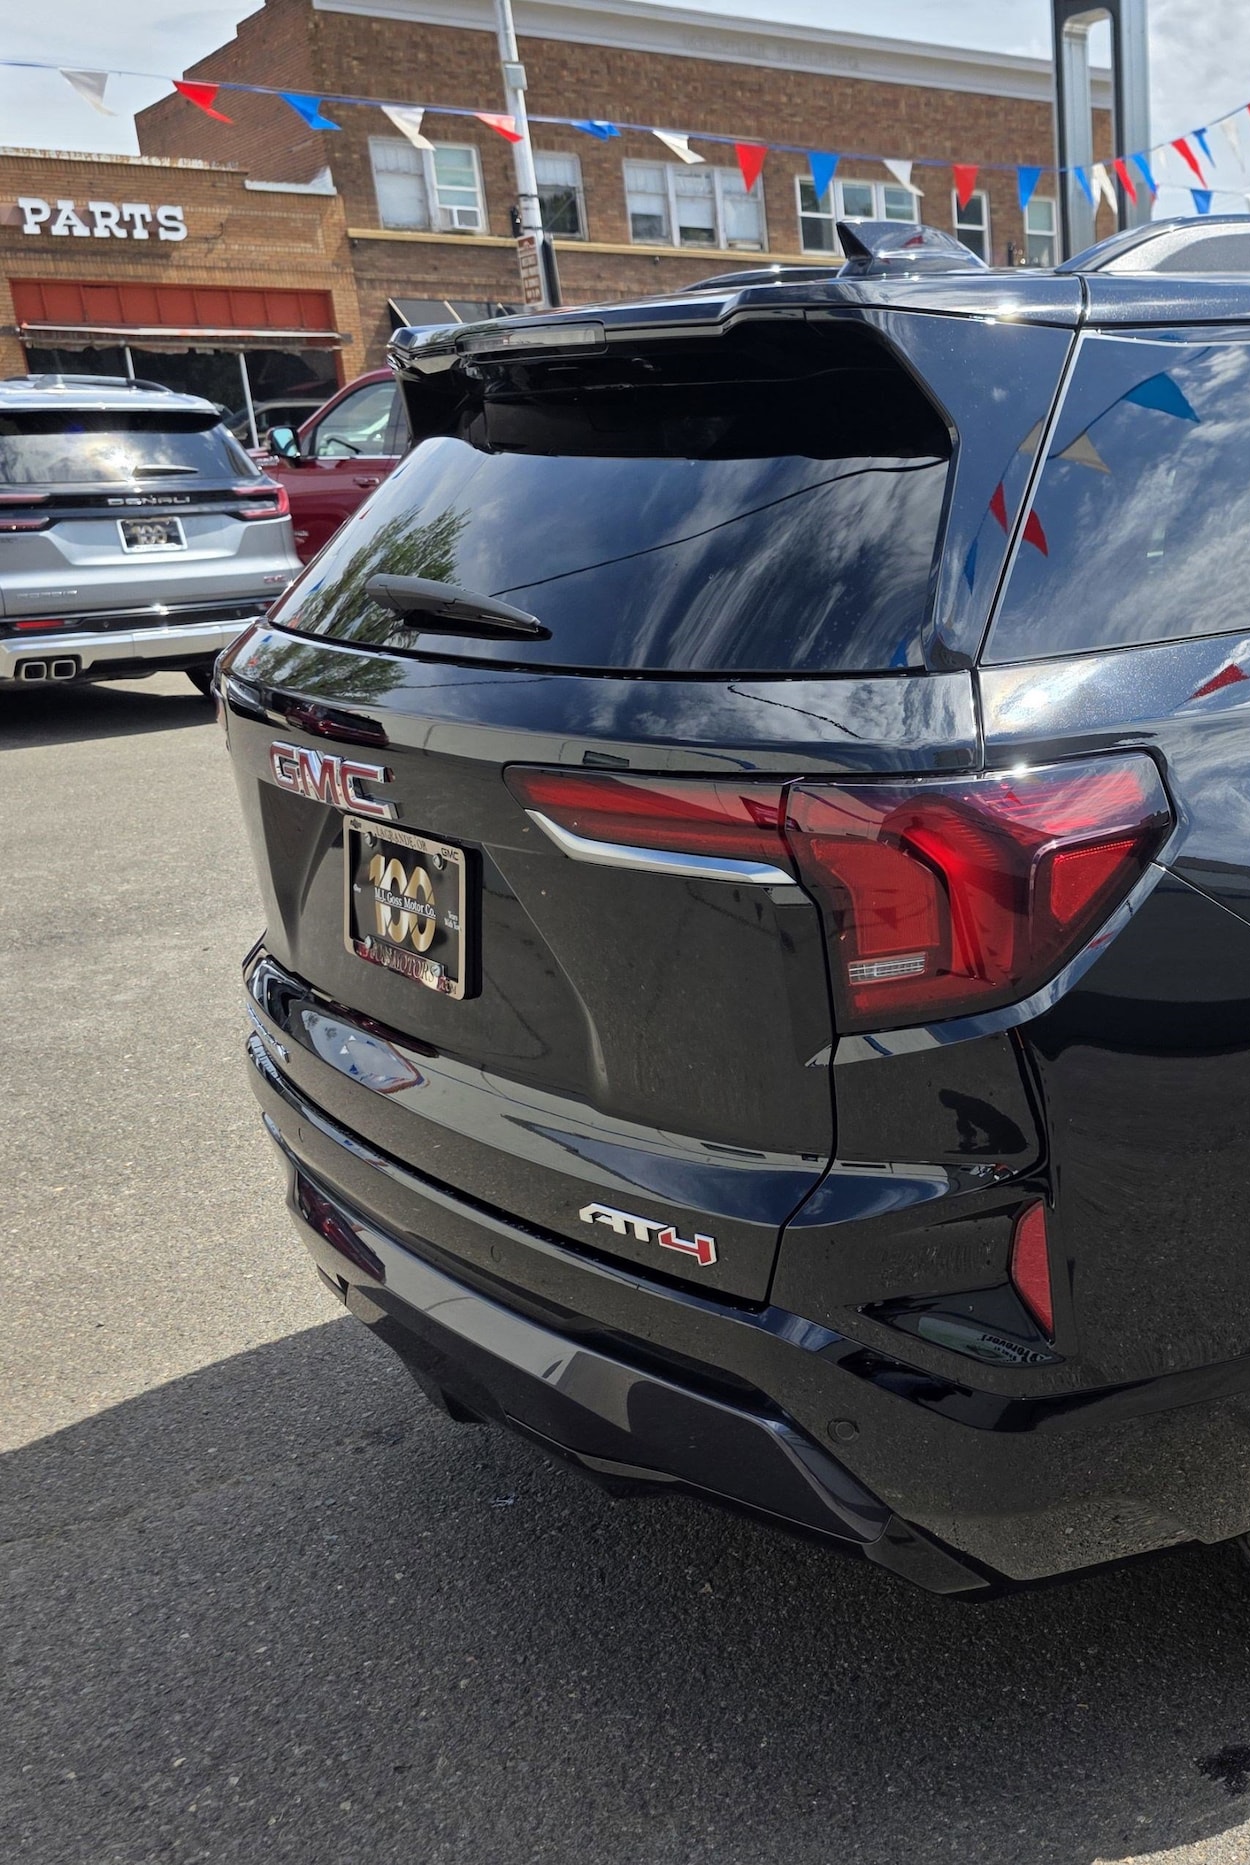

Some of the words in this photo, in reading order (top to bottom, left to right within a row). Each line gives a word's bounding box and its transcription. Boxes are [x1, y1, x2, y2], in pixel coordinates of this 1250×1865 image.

[18, 197, 188, 242] PARTS
[107, 495, 191, 506] DENALI
[269, 740, 399, 820] GMC
[441, 847, 459, 861] GMC
[387, 892, 402, 907] Goss
[404, 896, 424, 912] Motor
[425, 904, 437, 918] Co.
[579, 1202, 717, 1266] AT4
